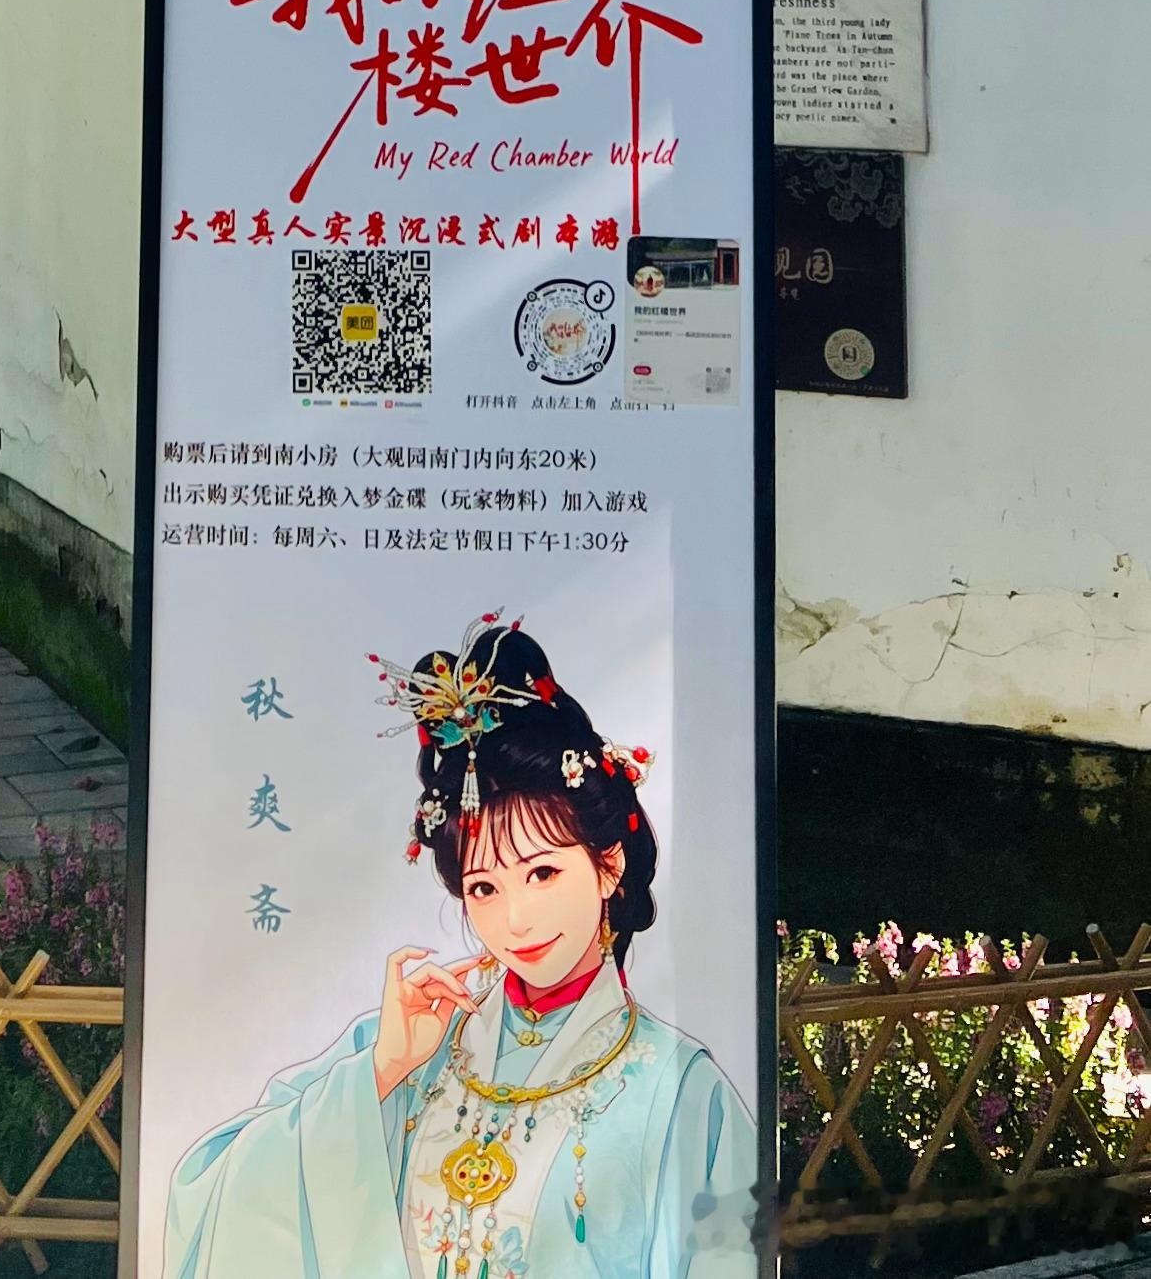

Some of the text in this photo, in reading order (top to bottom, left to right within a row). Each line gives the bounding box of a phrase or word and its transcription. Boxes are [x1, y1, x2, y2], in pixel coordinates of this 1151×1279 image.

[374, 142, 413, 180] My
[427, 141, 480, 171] Red
[489, 137, 594, 172] Chamber
[466, 394, 518, 410] 打开抖音
[531, 394, 597, 411] 点击左上角
[241, 676, 294, 934] 秋爽斋
